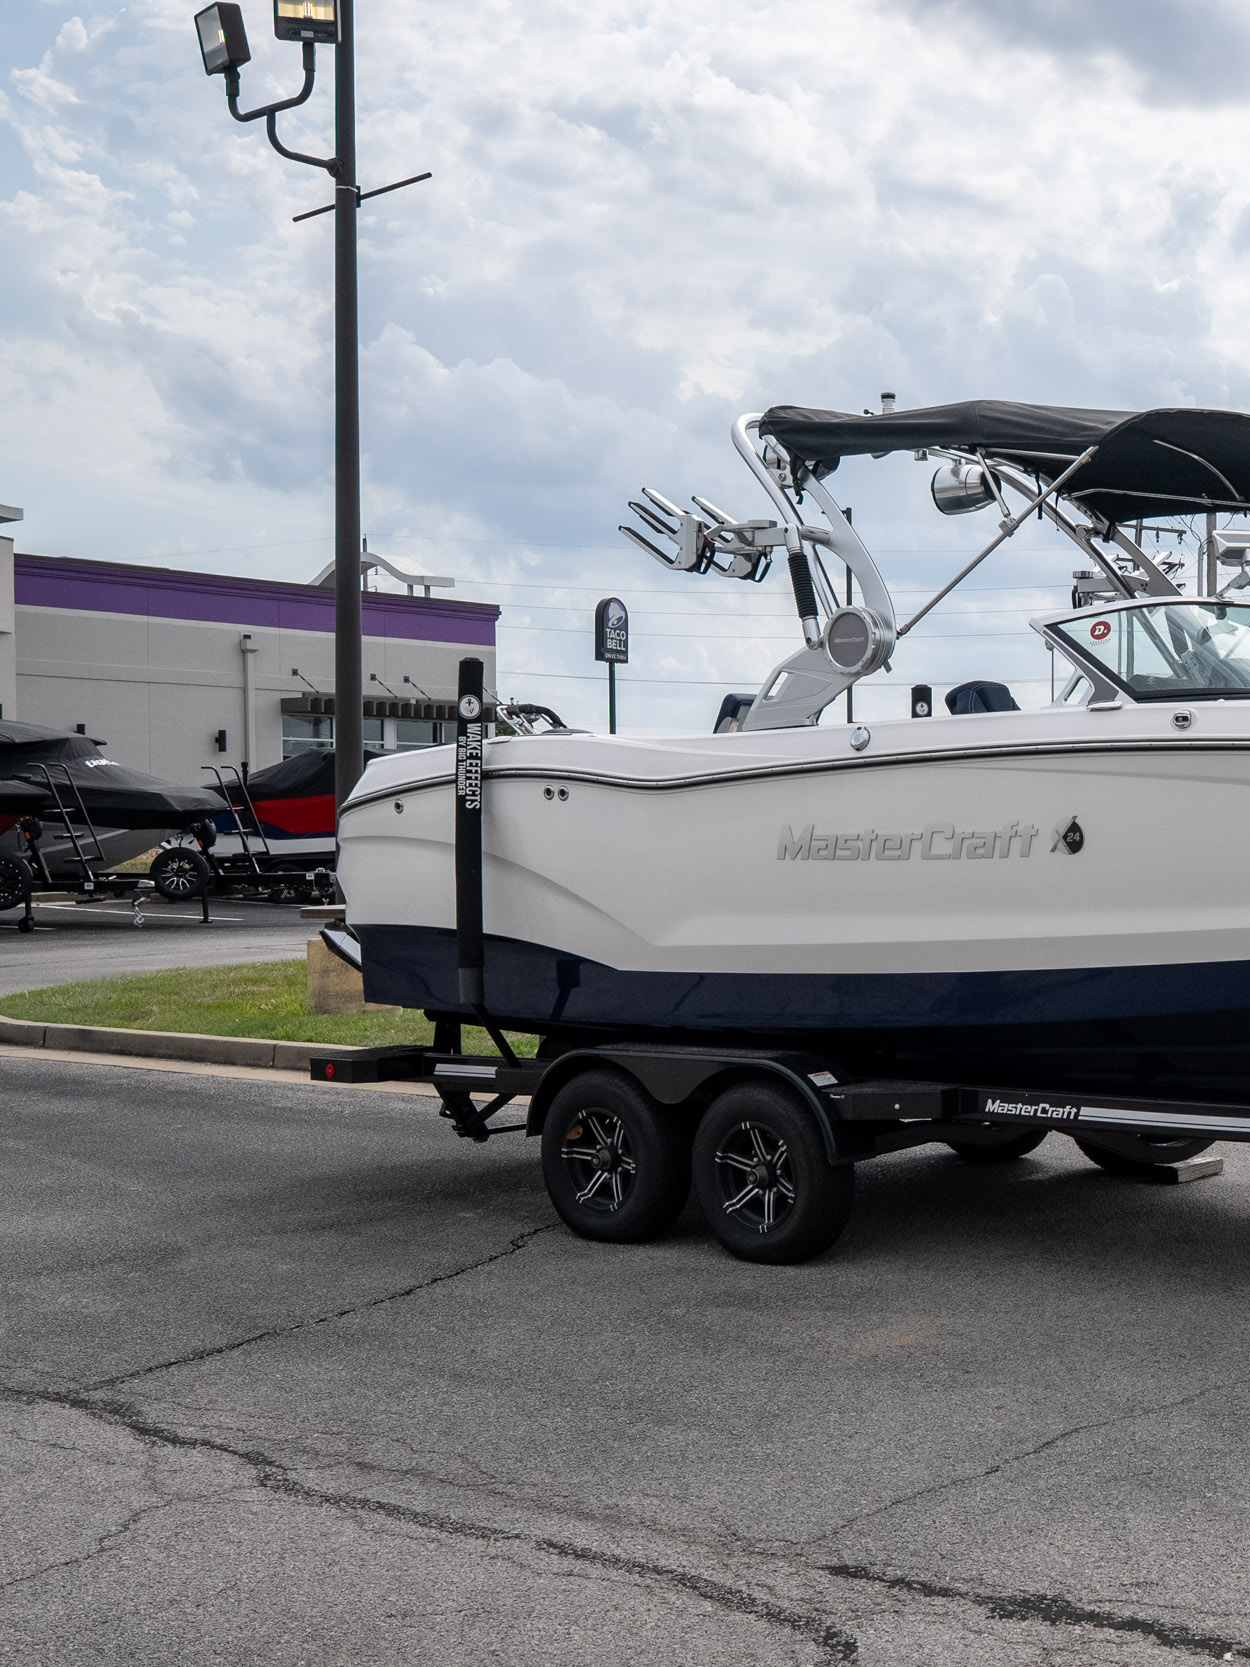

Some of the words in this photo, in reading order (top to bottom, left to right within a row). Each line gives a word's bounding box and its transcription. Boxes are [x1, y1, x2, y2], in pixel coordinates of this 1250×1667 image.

[605, 628, 626, 641] TACO
[606, 638, 626, 651] BELL
[458, 736, 467, 747] BY
[466, 723, 482, 757] WAKE
[458, 748, 467, 760] BIG
[457, 761, 467, 796] THUNDER
[465, 759, 481, 809] EFFECTS
[776, 819, 1039, 861] MasterCraft
[985, 1098, 1078, 1120] MasterCraft
